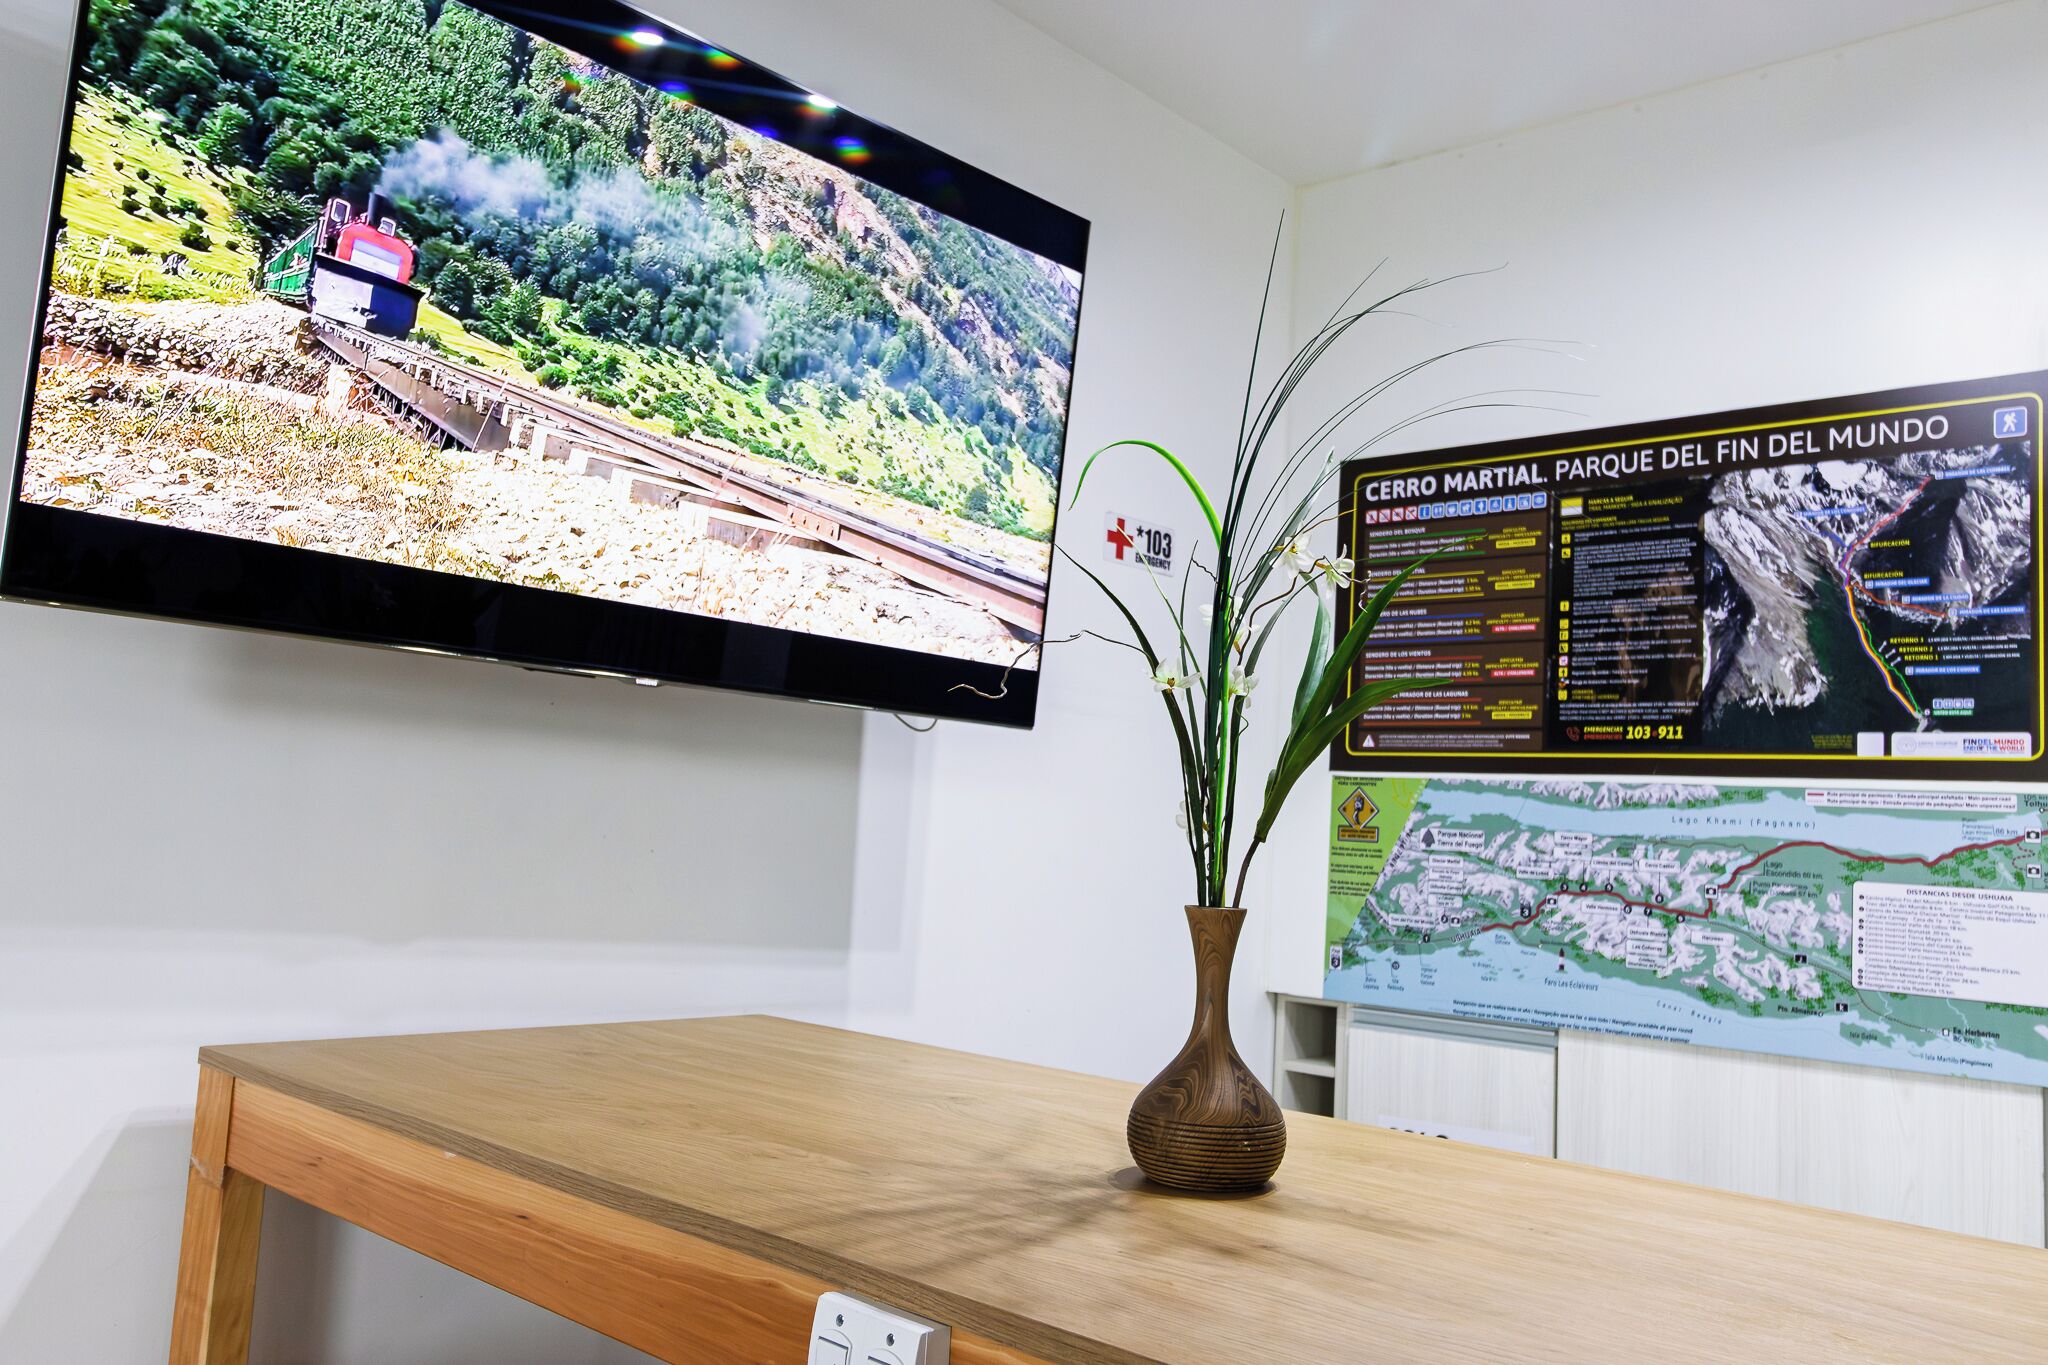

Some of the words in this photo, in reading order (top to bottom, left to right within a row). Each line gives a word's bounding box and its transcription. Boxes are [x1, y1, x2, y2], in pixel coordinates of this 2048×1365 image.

[1365, 476, 1437, 502] CERRO
[1444, 463, 1548, 494] MARTIAL.
[1555, 449, 1653, 481] PARQUE
[1662, 444, 1709, 470] DEL
[1717, 436, 1758, 464] FIN
[1769, 430, 1820, 458] DEL
[1828, 414, 1949, 450] MUNDO
[1626, 726, 1651, 739] 103
[1658, 726, 1683, 739] 911
[1672, 816, 1698, 825] Lago
[1706, 816, 1742, 825] Khami
[1750, 819, 1816, 830] (Fagnano)
[1438, 830, 1457, 839] Parque
[1766, 870, 1801, 878] Escondido
[1906, 889, 1950, 897] DISTANCIAS
[1978, 893, 2013, 902] USHUAIA
[1450, 929, 1481, 942] USHUAIA
[1544, 978, 1557, 987] Faro
[1656, 1000, 1682, 1013] Canal
